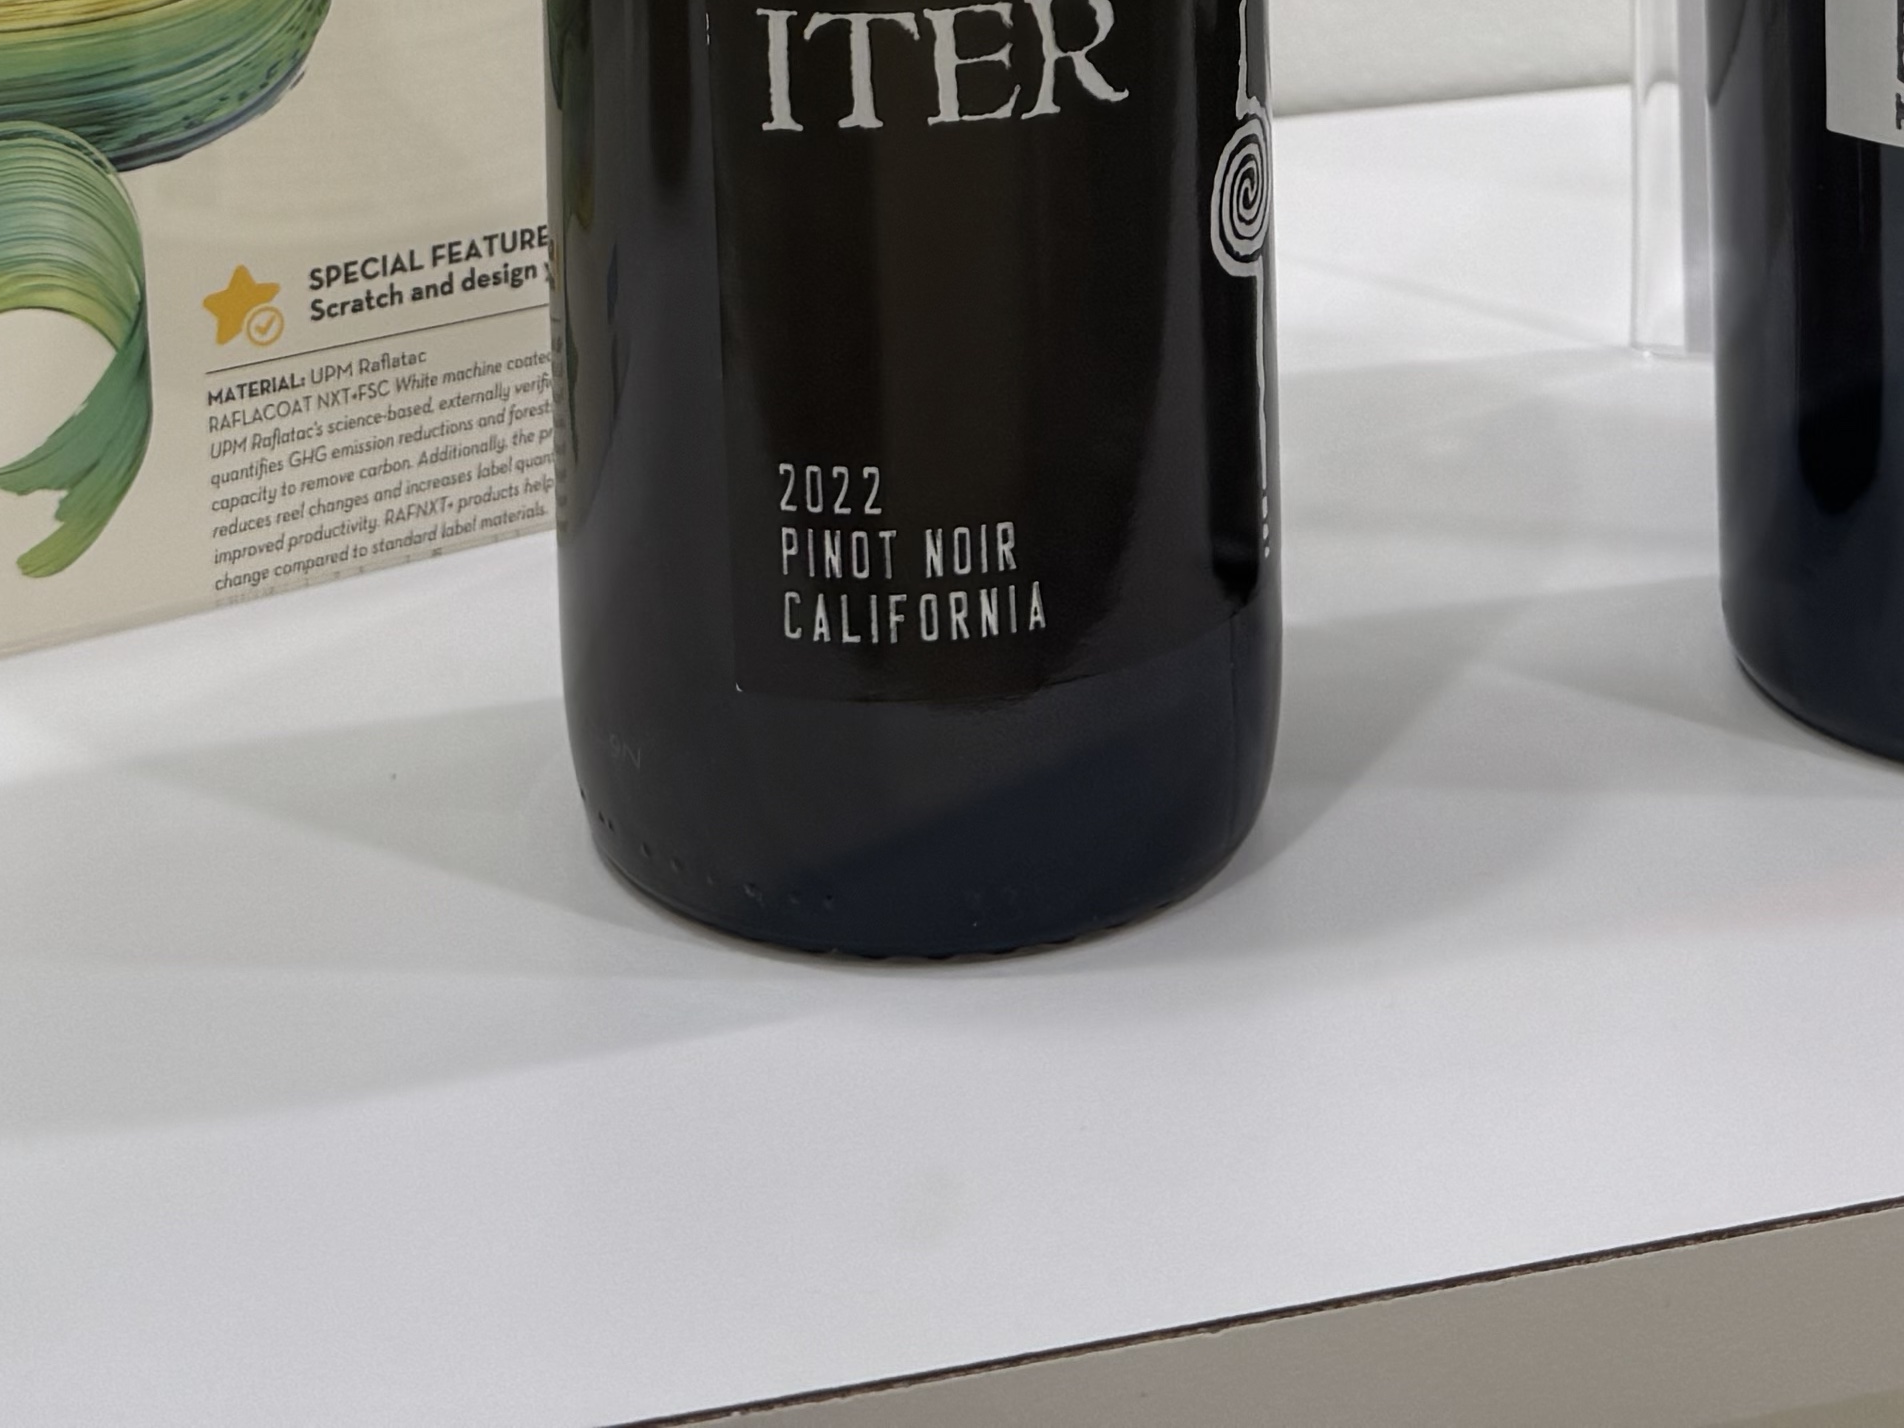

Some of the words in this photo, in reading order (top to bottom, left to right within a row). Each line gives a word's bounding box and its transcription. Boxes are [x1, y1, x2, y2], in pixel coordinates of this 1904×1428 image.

[308, 248, 424, 291] SPECIAL
[309, 284, 403, 321] Scratch
[410, 274, 454, 302] and
[460, 264, 537, 292] design
[207, 372, 305, 406] MATERIAL:
[310, 361, 353, 384] UPM
[358, 351, 426, 375] Raflatac
[208, 394, 312, 433] RAFLACOAT
[395, 372, 438, 393] White
[441, 360, 502, 384] machine
[209, 435, 247, 459] UPM
[250, 420, 323, 451] Raflatac's
[437, 381, 510, 410] externally
[209, 456, 284, 489] quantifies
[287, 443, 327, 468] GHG
[330, 435, 394, 459] emission
[397, 418, 473, 445] reductions
[476, 406, 506, 428] and
[210, 485, 277, 513] capacity
[280, 480, 297, 497] to
[299, 470, 355, 493] remove
[511, 428, 535, 446] the
[211, 514, 272, 538] reduces
[275, 501, 305, 524] reel
[307, 492, 369, 517] changes
[372, 480, 403, 503] and
[404, 469, 472, 495] increases
[476, 457, 513, 480] label
[778, 463, 884, 516] 2022
[214, 535, 283, 565] improved
[456, 485, 519, 514] products
[214, 567, 270, 591] change
[272, 544, 349, 577] compared
[351, 543, 368, 559] to
[371, 524, 438, 555] standard
[440, 516, 477, 539] label
[780, 526, 898, 581] PINOT
[925, 520, 1018, 577] NOIR
[782, 580, 1048, 646] CALIFORNIA
